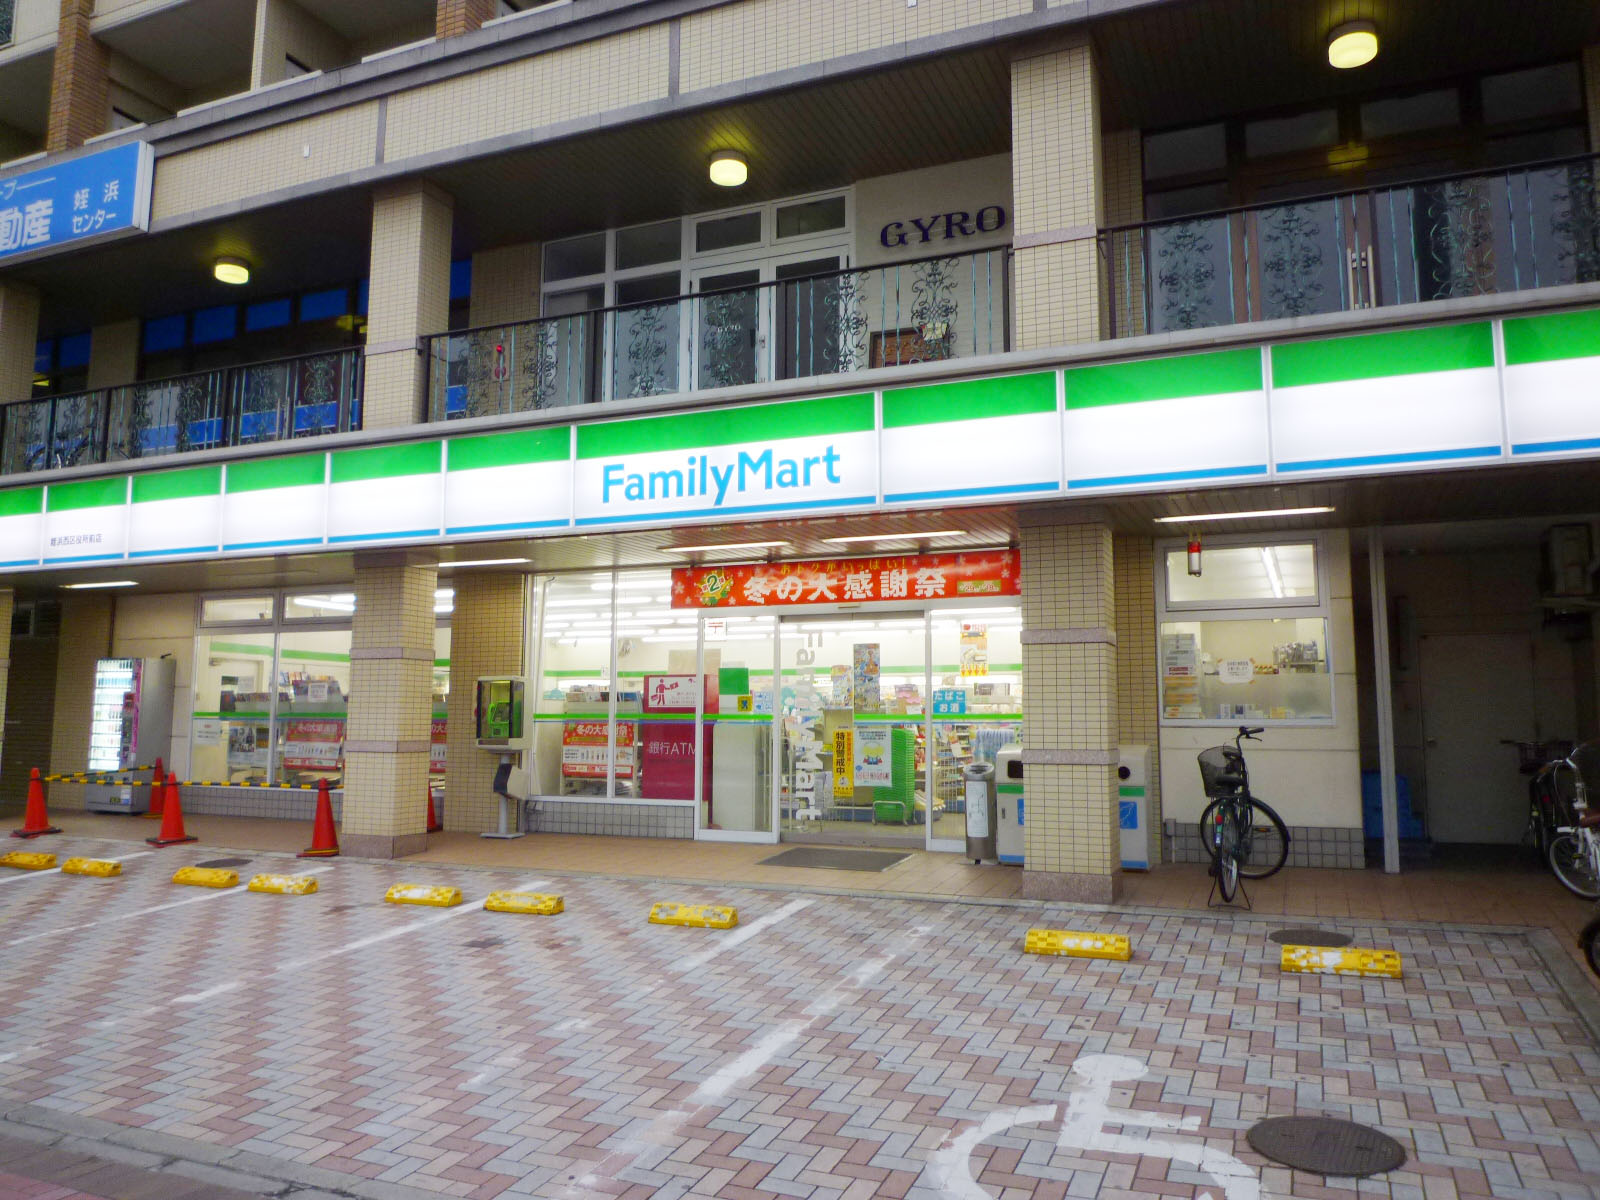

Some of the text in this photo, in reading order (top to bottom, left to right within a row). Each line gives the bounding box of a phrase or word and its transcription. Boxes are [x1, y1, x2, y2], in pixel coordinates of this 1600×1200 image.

[72, 208, 117, 233] センター
[880, 205, 1006, 248] GYRO
[602, 444, 841, 506] FamilyMart
[744, 566, 947, 604] 冬の大感謝祭
